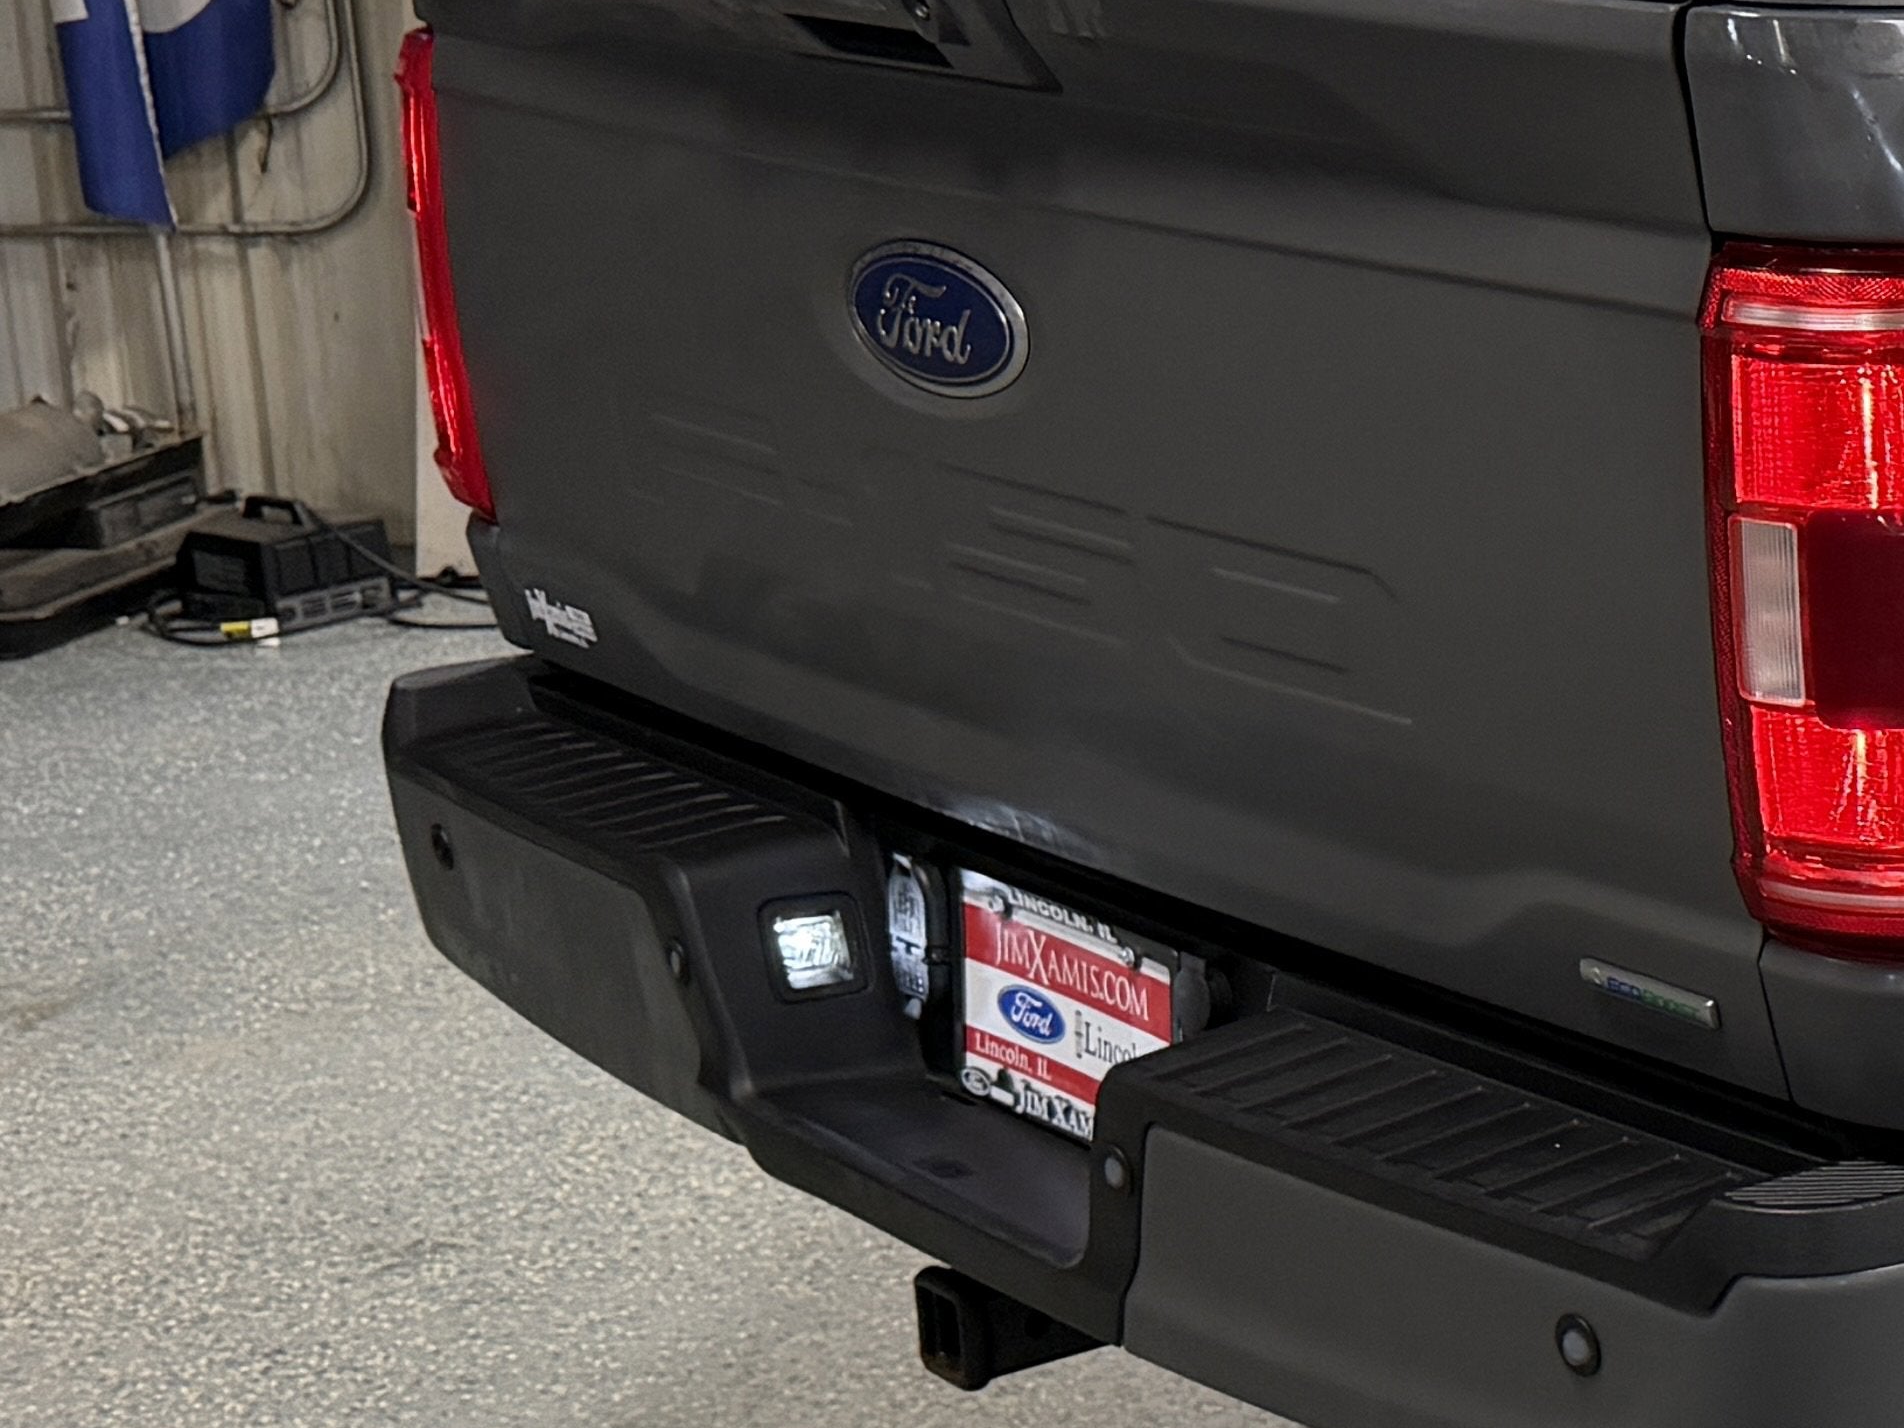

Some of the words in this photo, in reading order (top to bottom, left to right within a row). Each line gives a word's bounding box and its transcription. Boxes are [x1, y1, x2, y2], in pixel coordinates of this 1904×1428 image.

[877, 273, 972, 365] Ford
[1010, 991, 1053, 1037] Ford
[1085, 1021, 1136, 1063] Linco
[1037, 1056, 1052, 1081] IL
[1051, 1095, 1094, 1142] XAM
